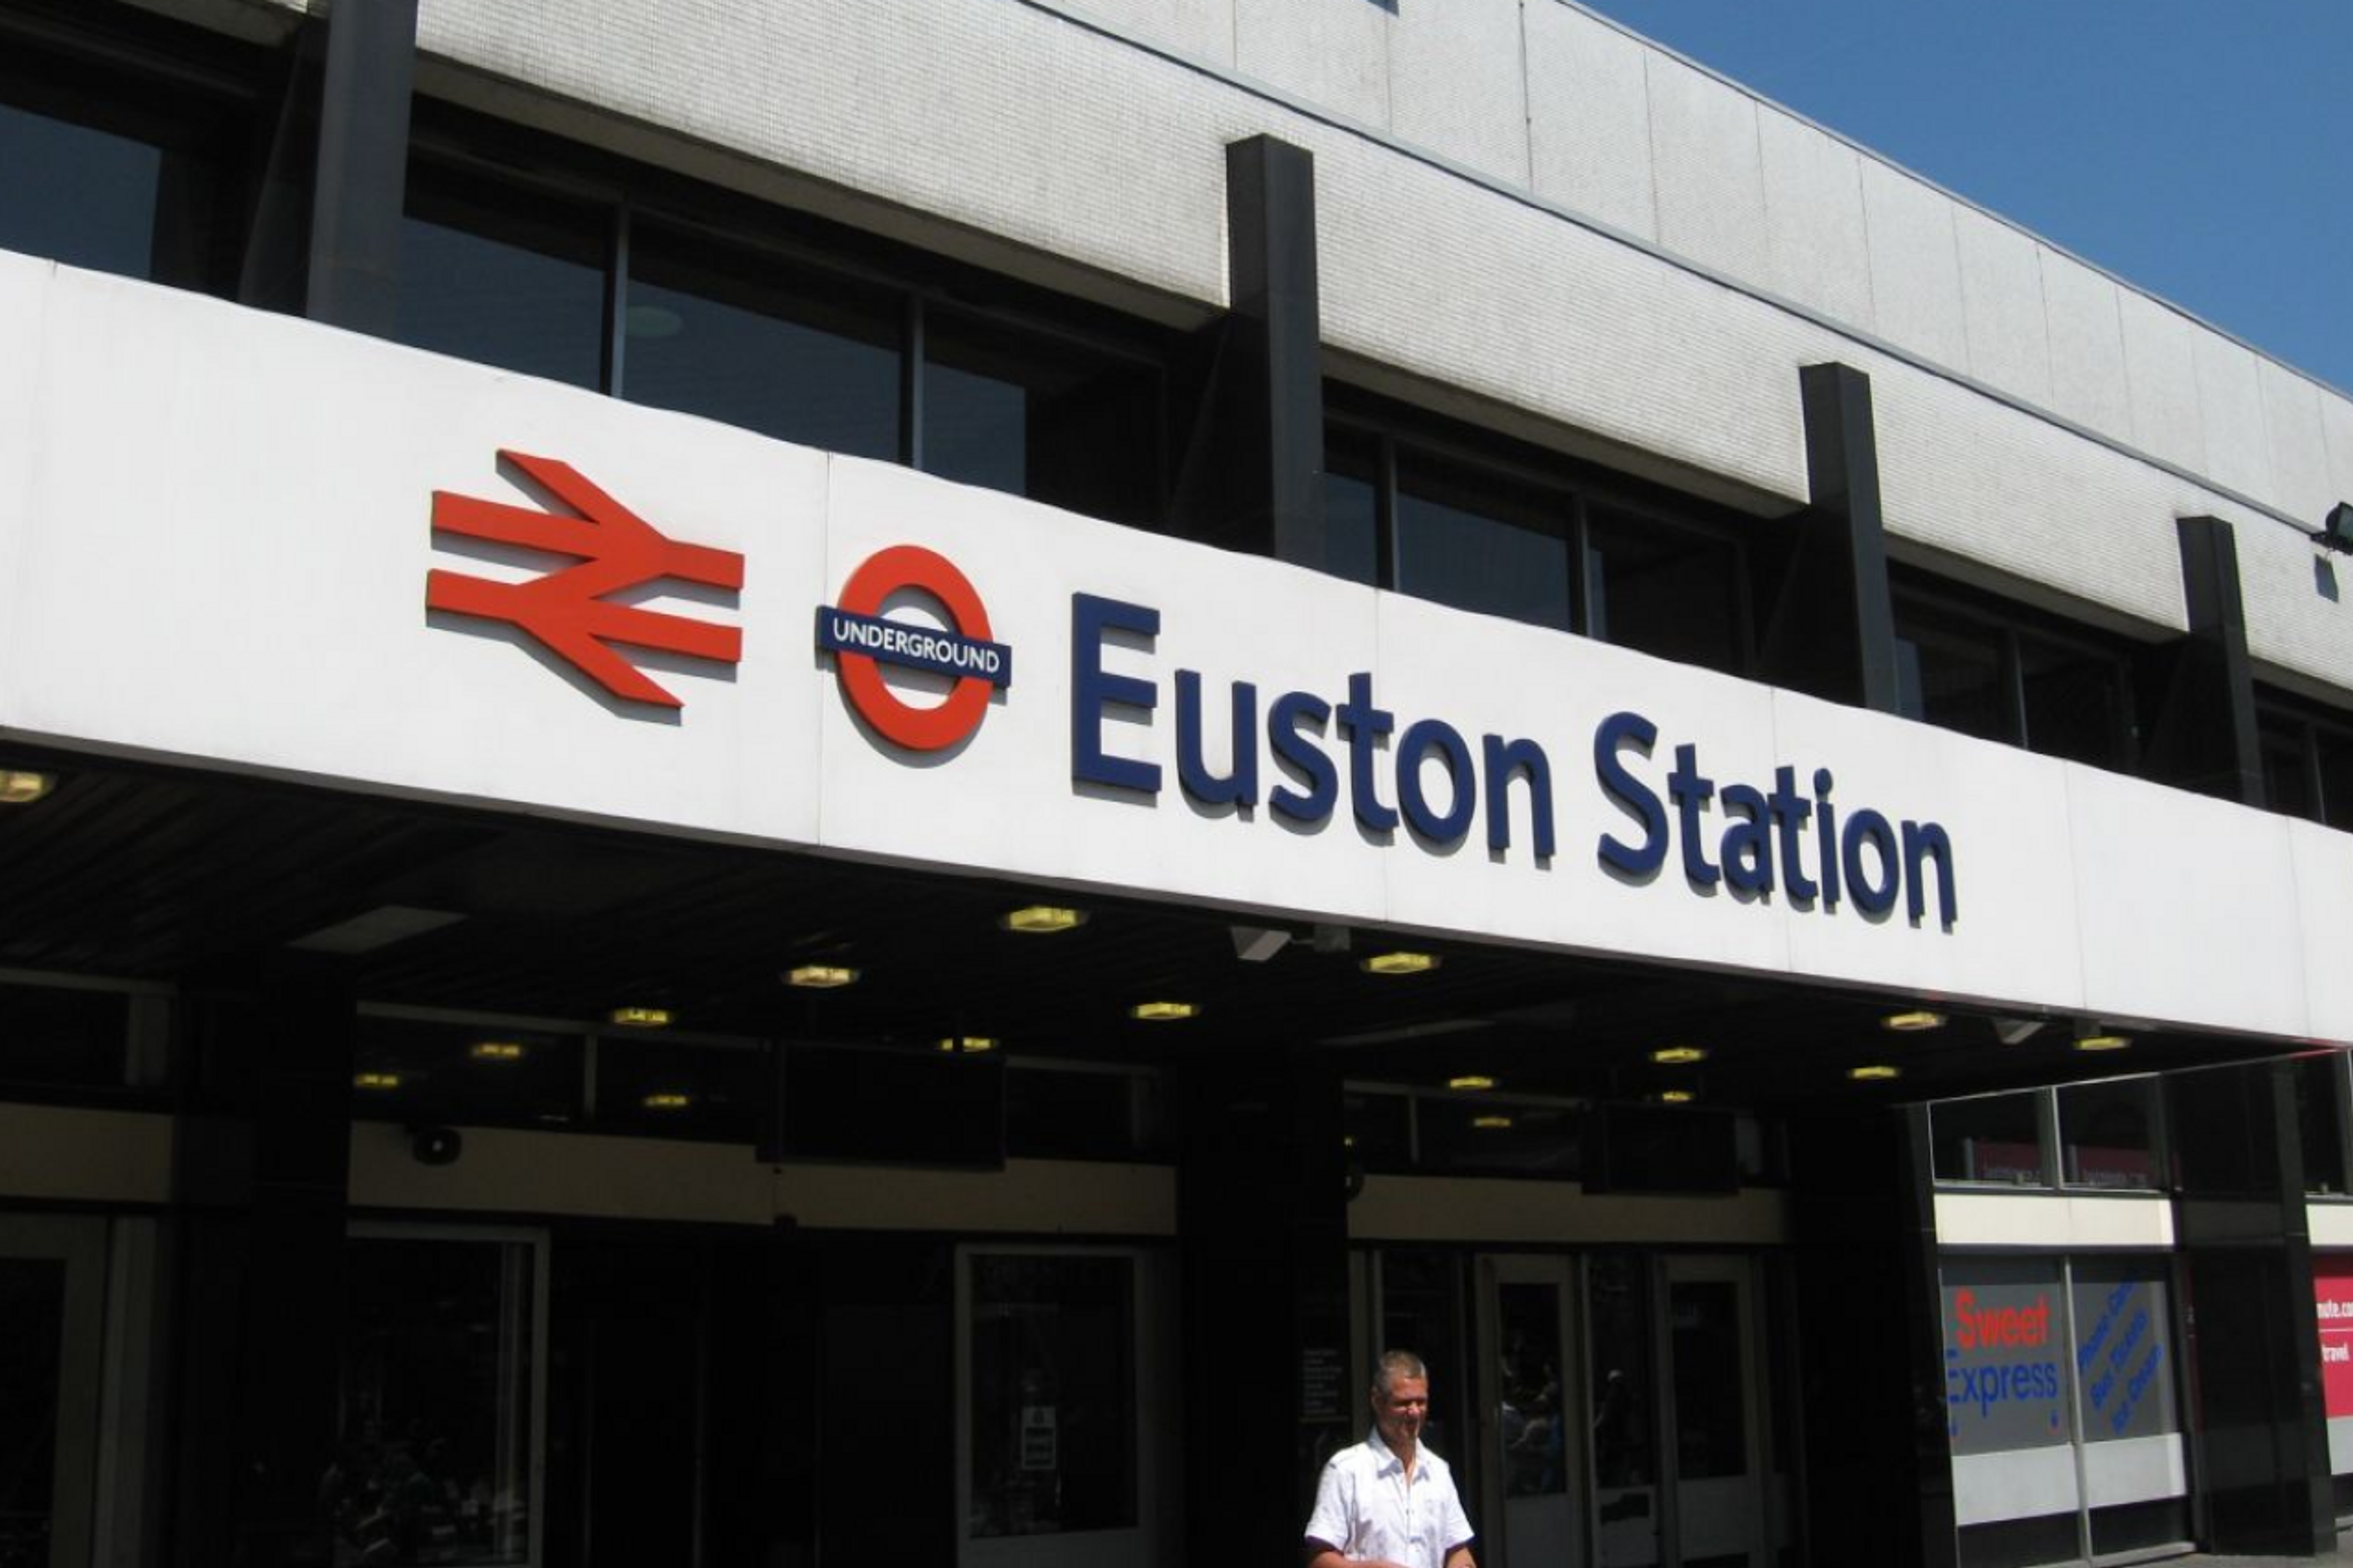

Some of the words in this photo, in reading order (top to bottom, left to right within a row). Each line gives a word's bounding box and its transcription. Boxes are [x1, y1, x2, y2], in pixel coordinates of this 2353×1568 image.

[833, 616, 1000, 673] UNDERGROUND
[1072, 591, 1556, 858] Euston
[1593, 711, 1958, 923] Station
[1955, 1288, 2049, 1350] Sweet
